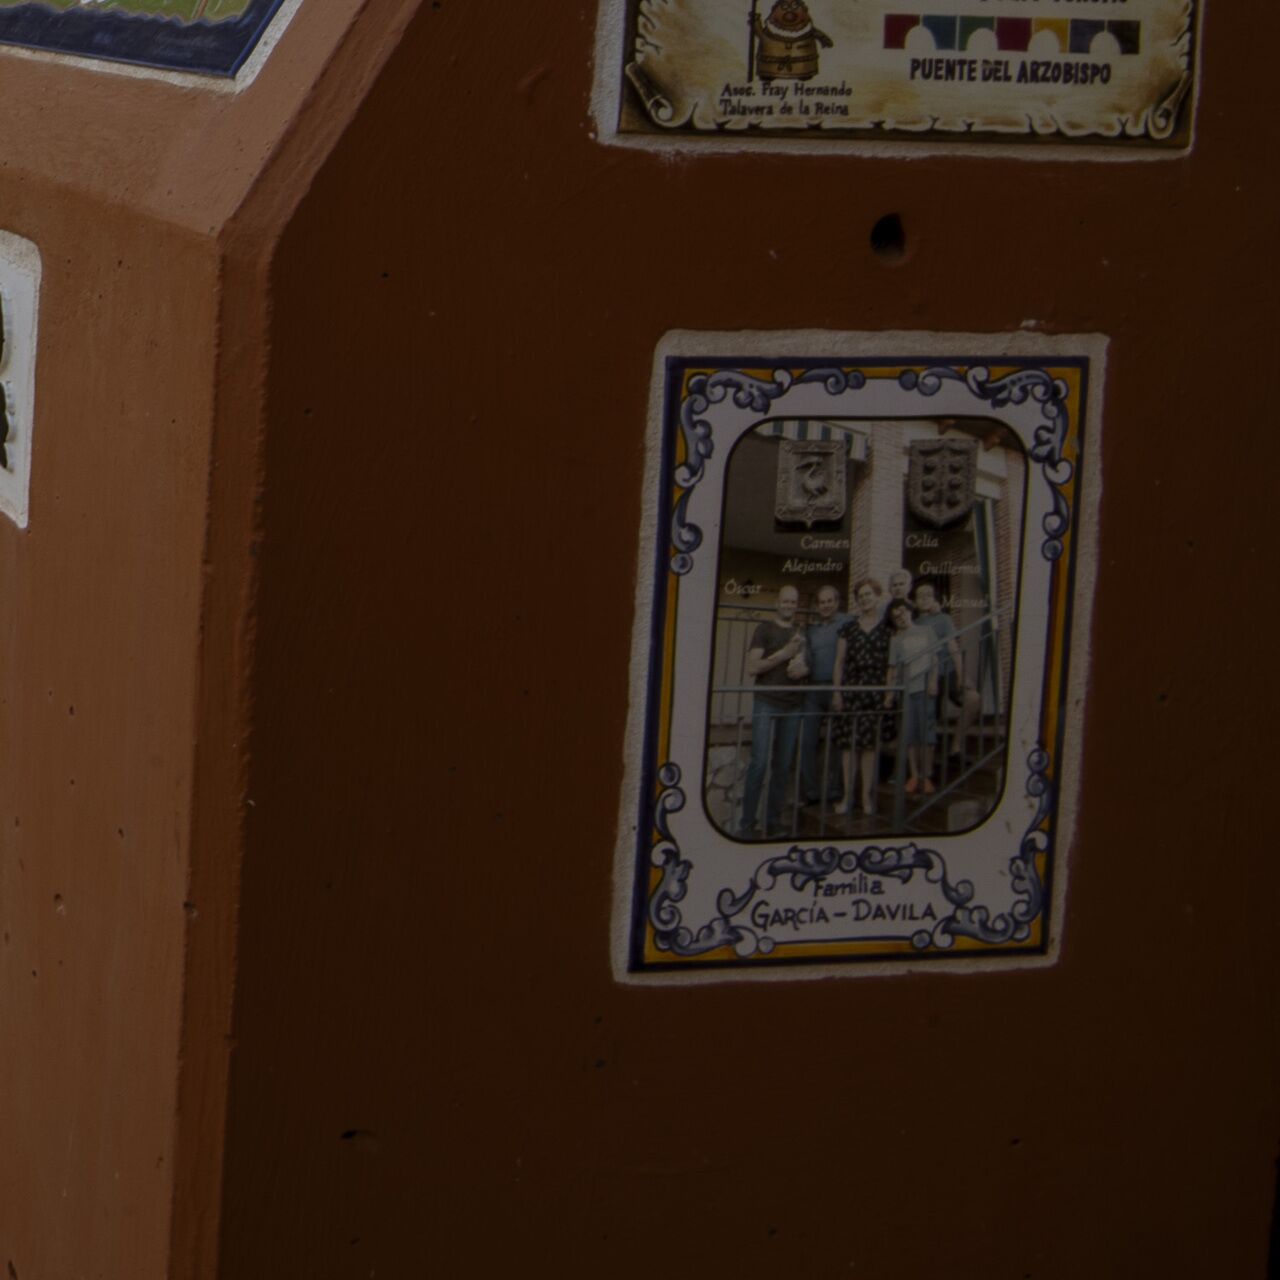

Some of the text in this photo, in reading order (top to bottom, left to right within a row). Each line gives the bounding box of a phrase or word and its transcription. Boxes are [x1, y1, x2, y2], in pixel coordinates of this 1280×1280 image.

[909, 57, 1112, 85] PUENTE DEL ARZOBISPO
[721, 80, 853, 100] Asoc. Fray Hernando
[719, 98, 850, 117] Talavera de la Reina
[800, 534, 850, 550] Carmen
[905, 533, 939, 549] Celia
[781, 556, 844, 575] Alejandro
[918, 560, 982, 576] Guillermo
[724, 577, 762, 596] Óscar
[813, 873, 885, 898] Familia
[750, 899, 830, 932] GARCÍA
[851, 898, 937, 922] DAVILA
